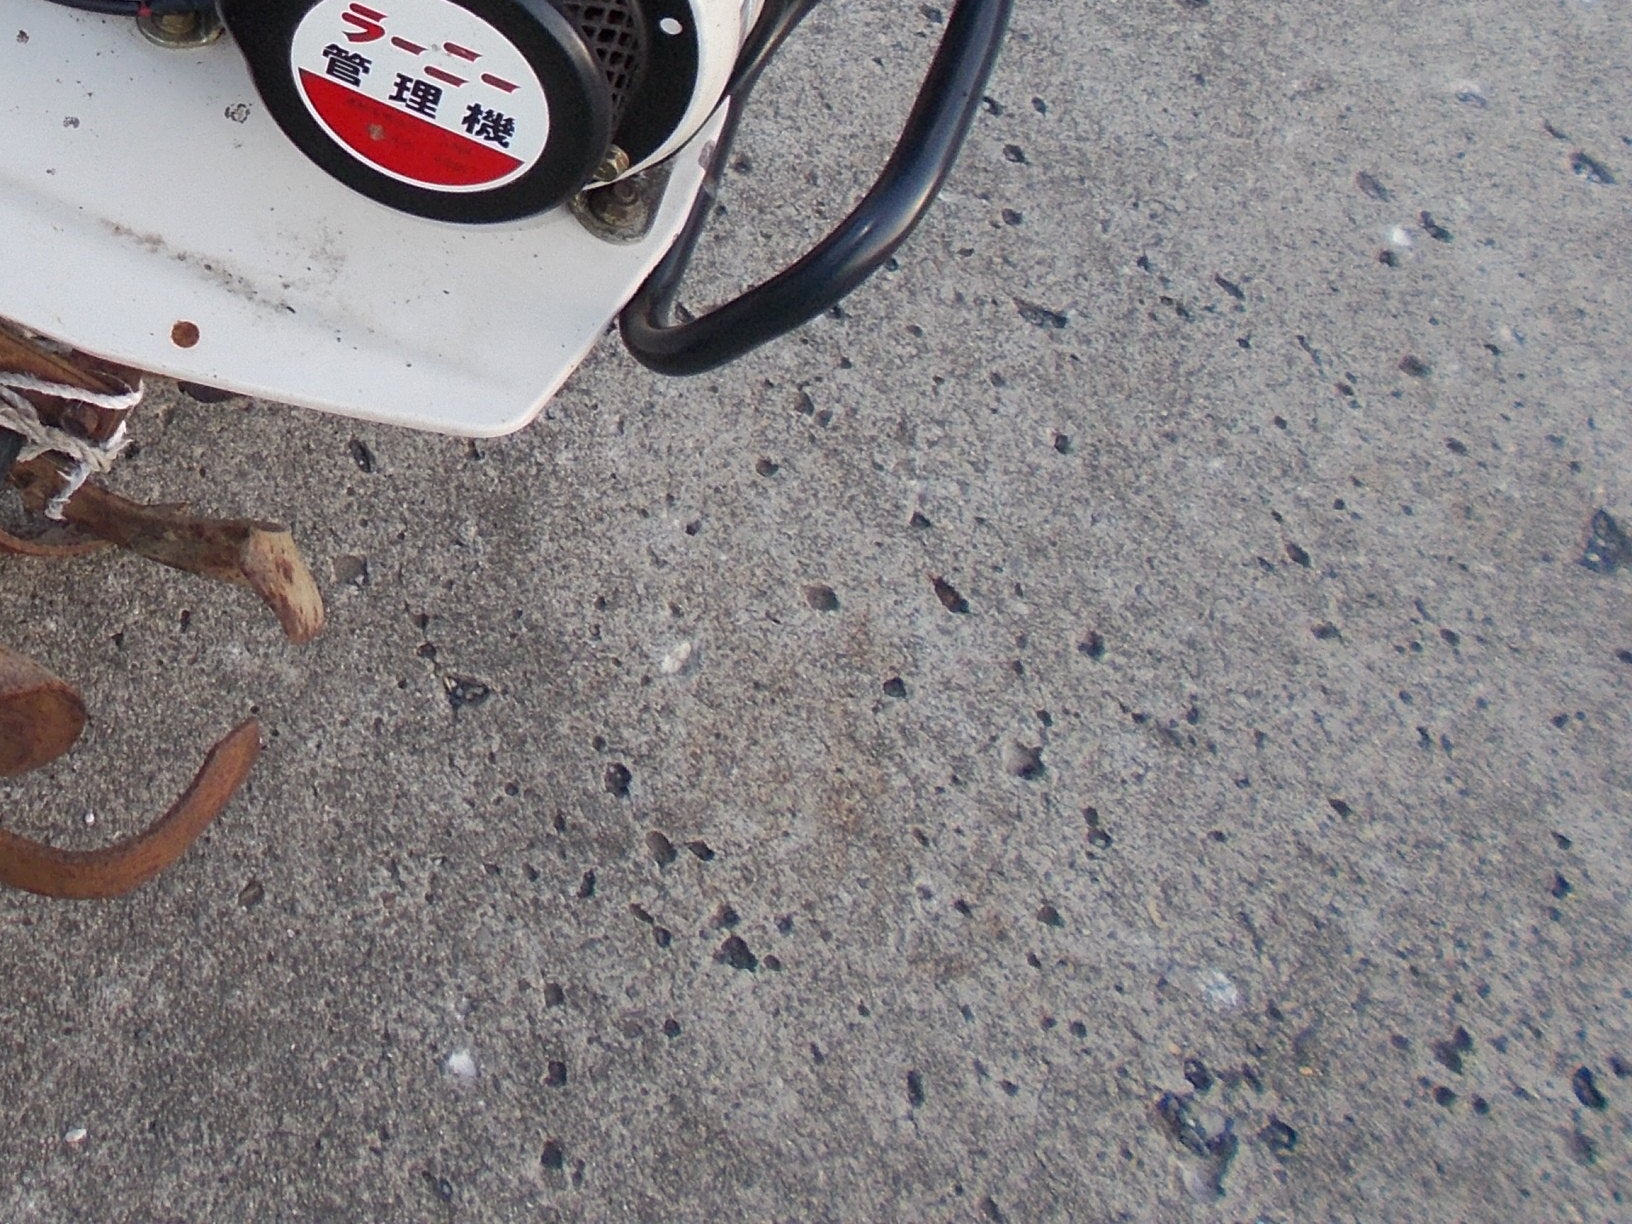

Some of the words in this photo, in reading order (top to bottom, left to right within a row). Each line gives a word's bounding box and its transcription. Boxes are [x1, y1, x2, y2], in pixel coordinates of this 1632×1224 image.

[322, 44, 516, 148] 管理機
[340, 2, 521, 94] ラーニー
